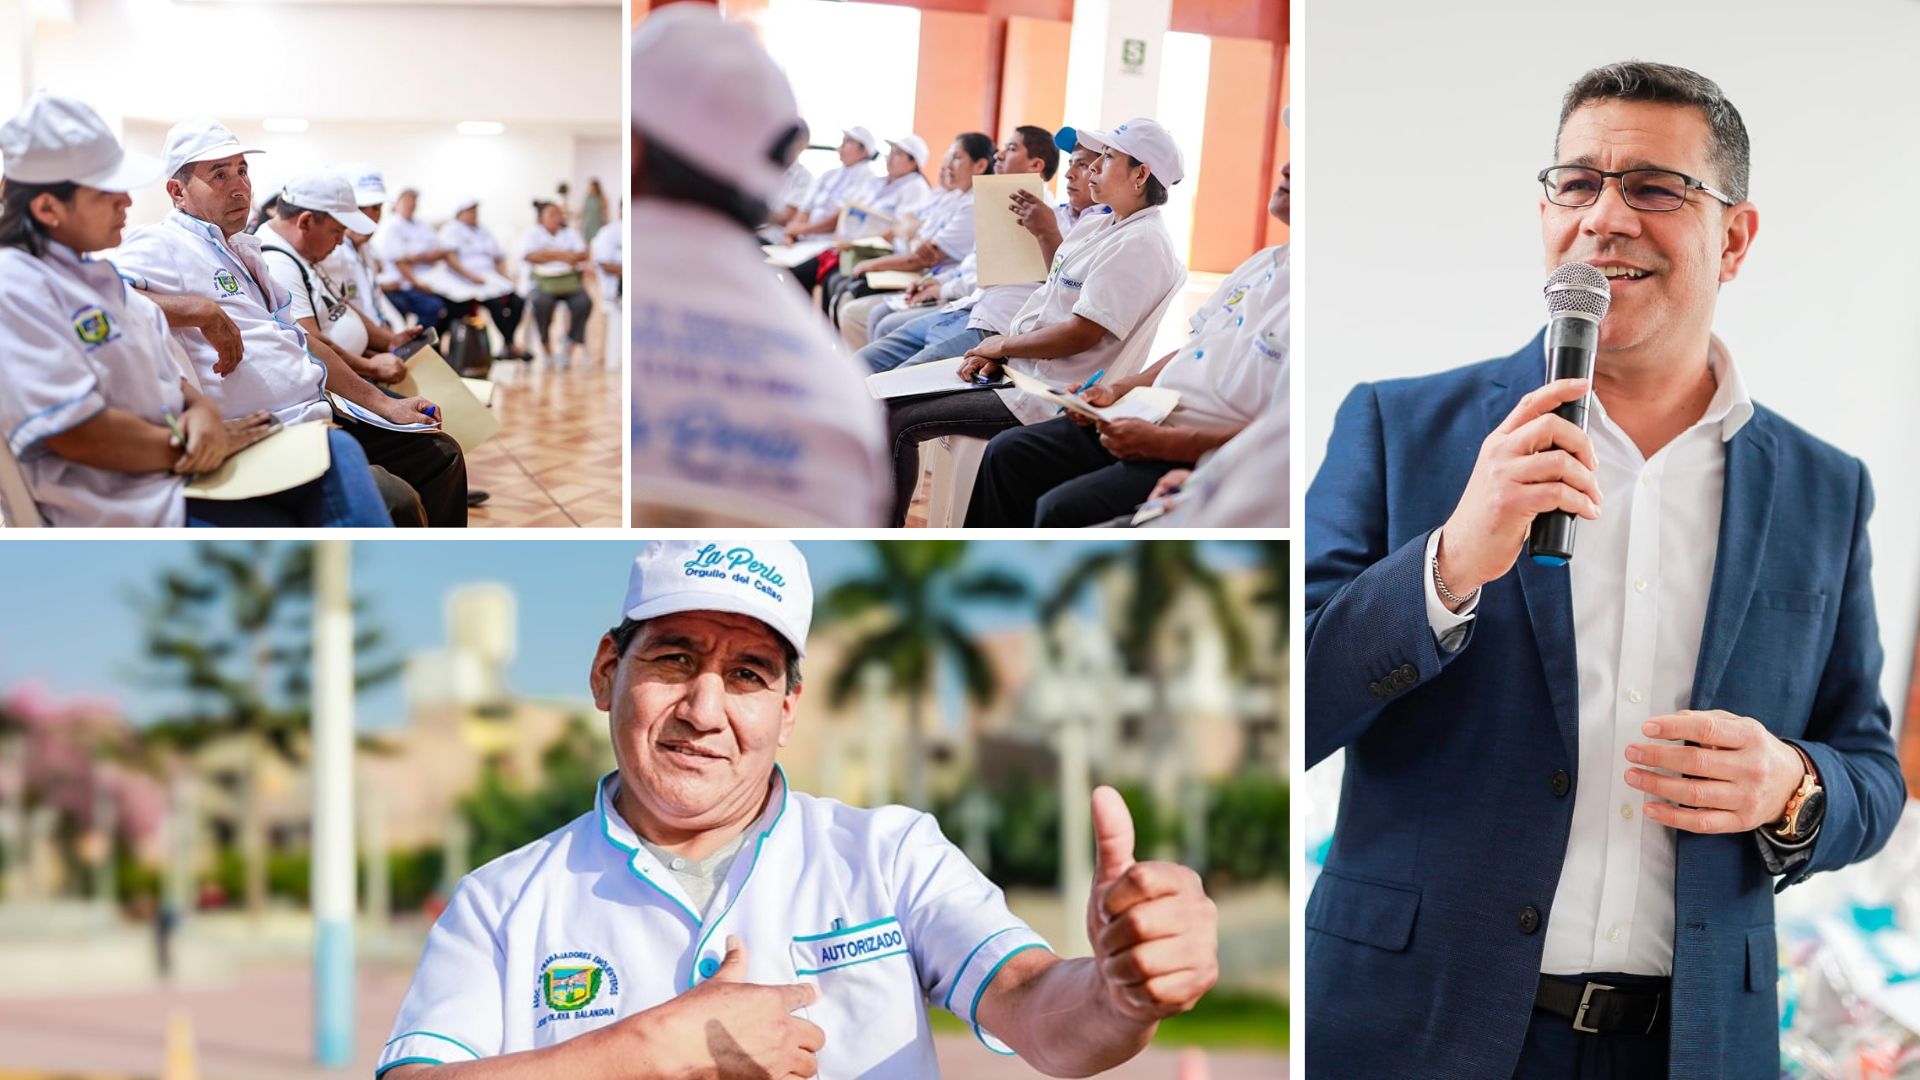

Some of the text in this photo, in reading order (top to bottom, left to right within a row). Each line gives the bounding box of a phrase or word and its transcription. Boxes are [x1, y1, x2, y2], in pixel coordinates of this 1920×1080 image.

[684, 543, 786, 588] La Perla
[685, 567, 782, 603] Orgullo del Callao
[822, 930, 902, 964] AUTORIZADO
[574, 1007, 615, 1019] BALANDRA
